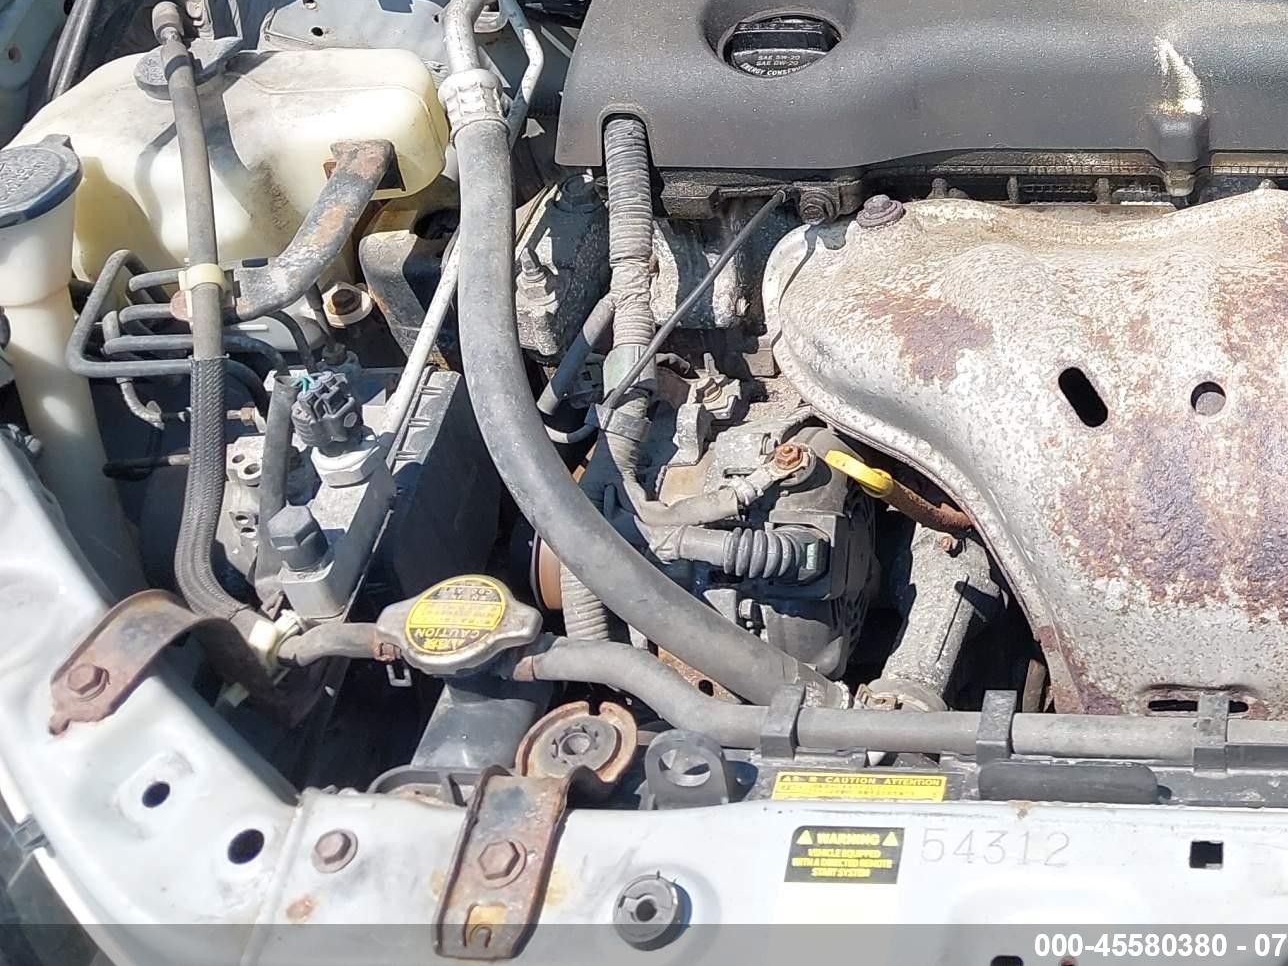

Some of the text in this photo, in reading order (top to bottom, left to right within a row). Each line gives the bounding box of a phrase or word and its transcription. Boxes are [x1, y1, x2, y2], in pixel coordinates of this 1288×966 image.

[414, 627, 480, 639] CAUTION
[825, 776, 876, 785] CAUTION
[884, 778, 941, 786] ATTENTION
[816, 832, 881, 846] WARNING
[920, 826, 1070, 867] 54312
